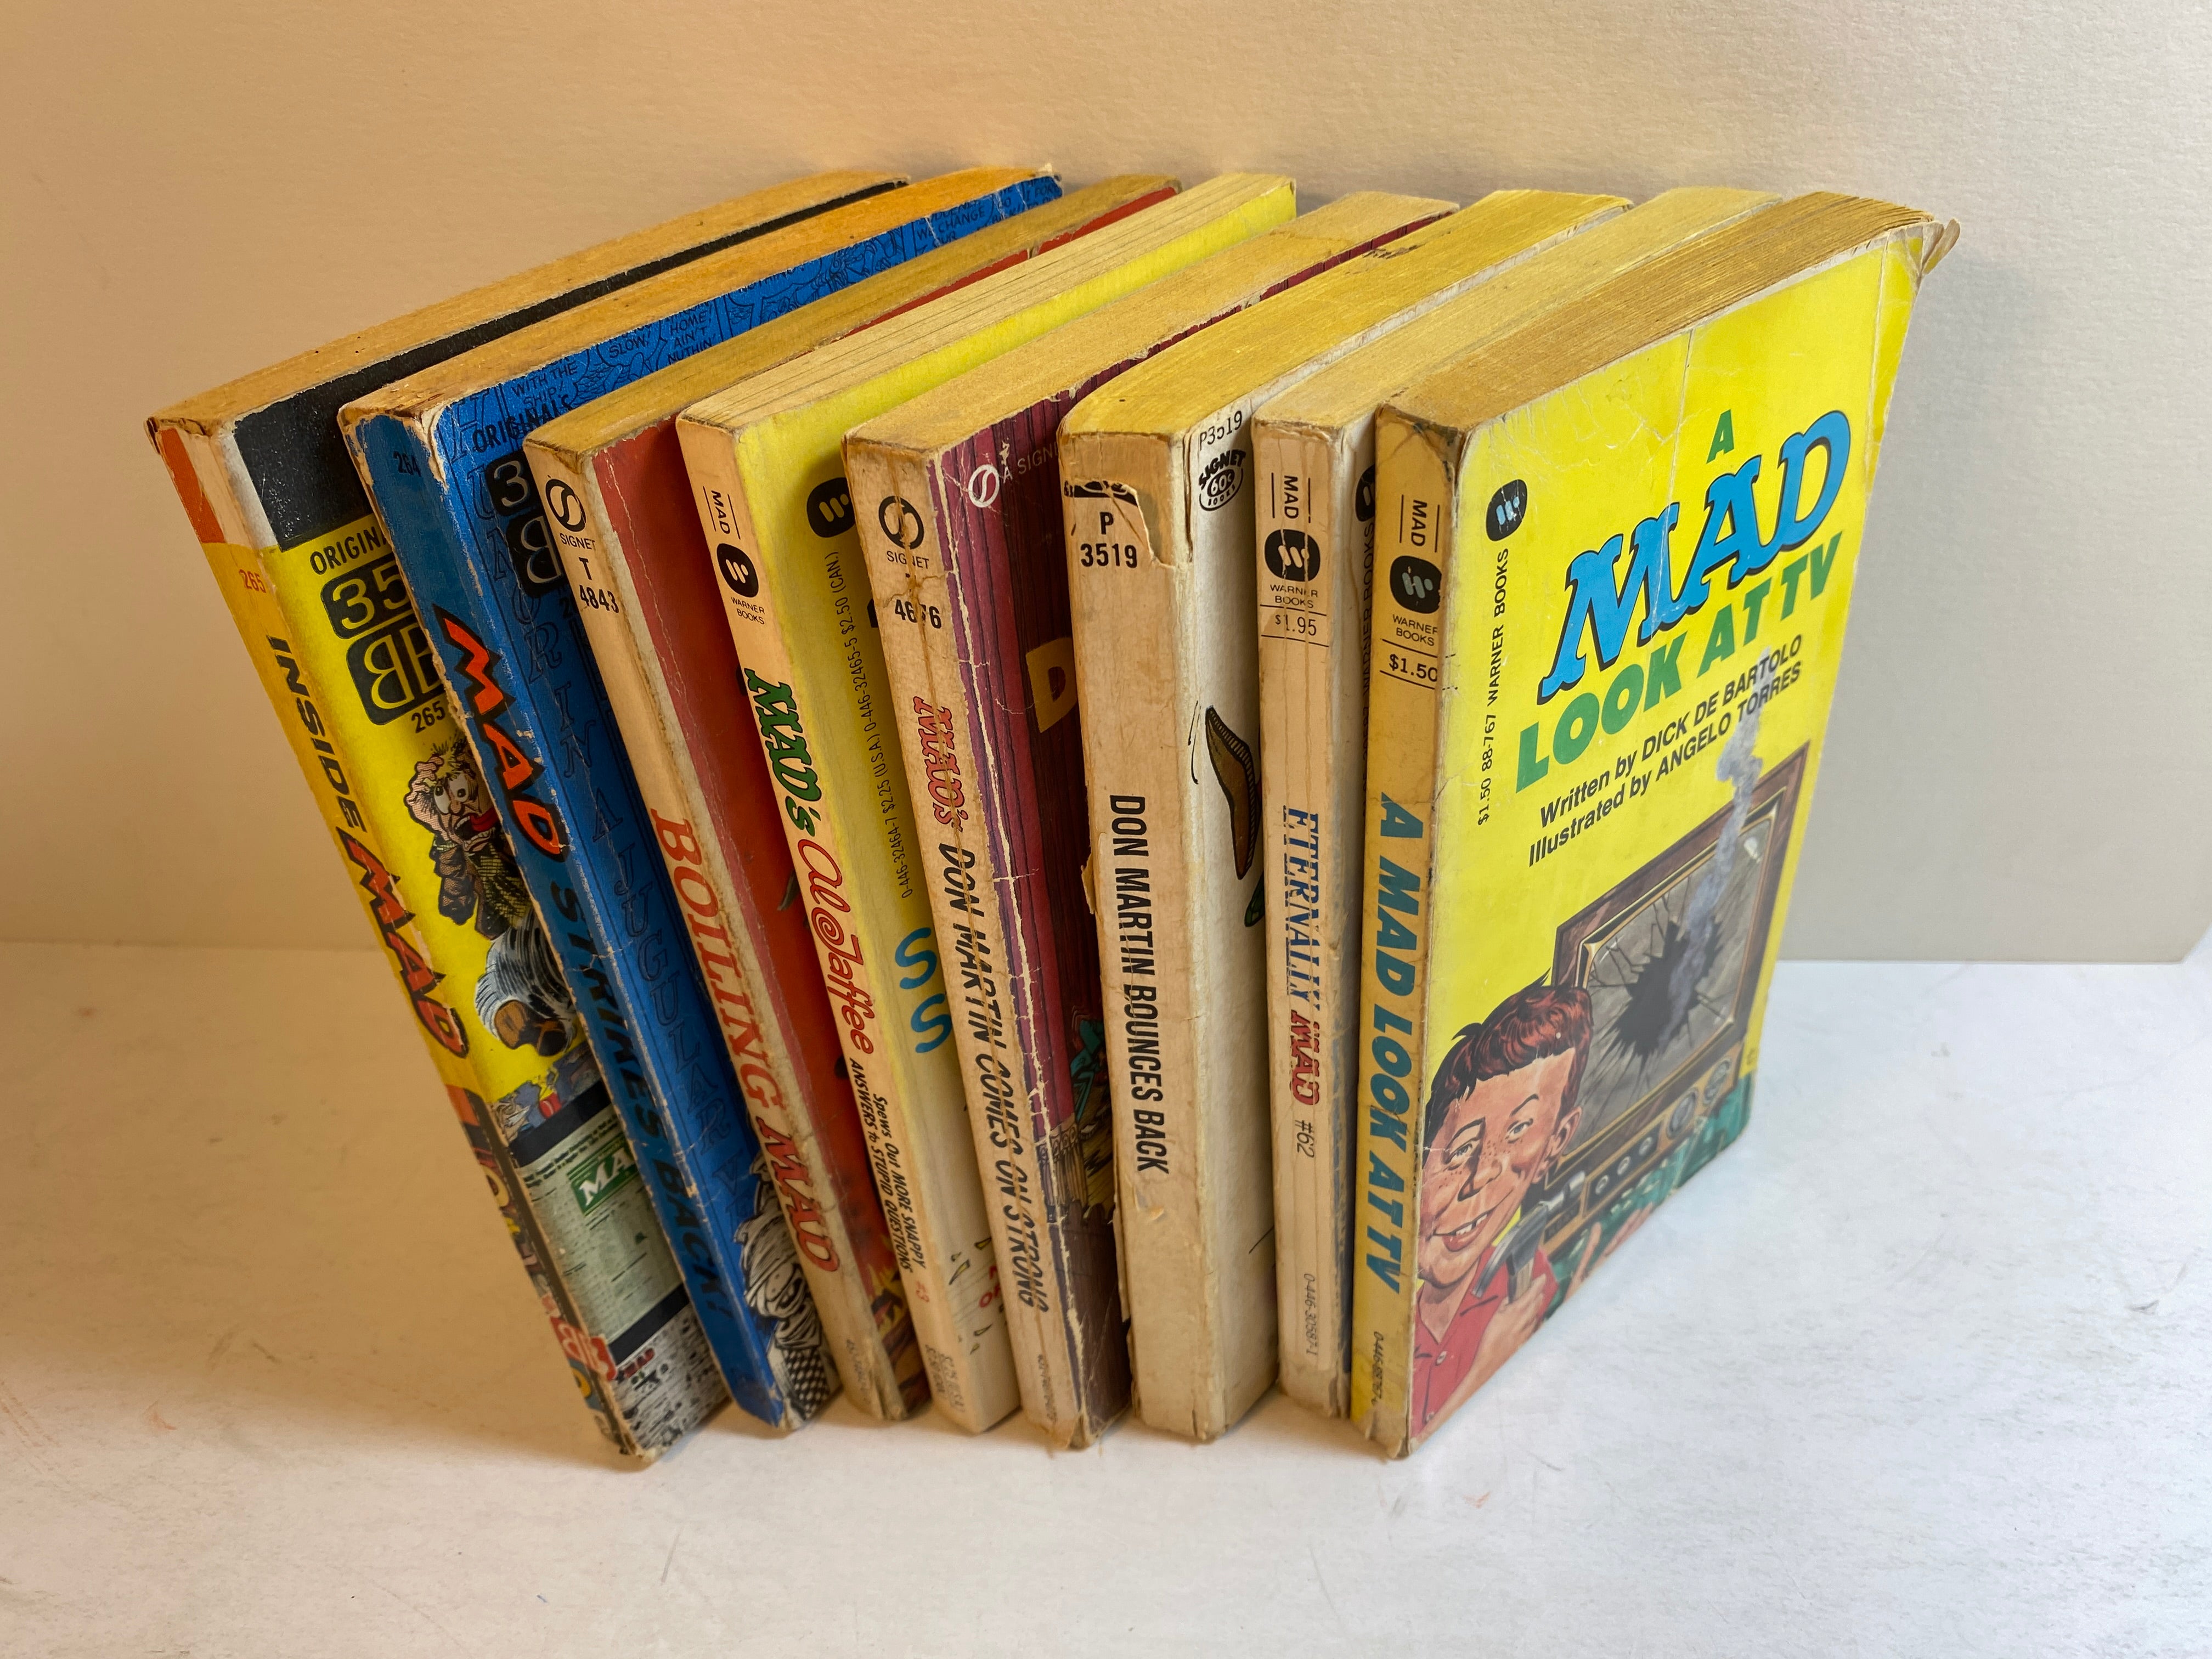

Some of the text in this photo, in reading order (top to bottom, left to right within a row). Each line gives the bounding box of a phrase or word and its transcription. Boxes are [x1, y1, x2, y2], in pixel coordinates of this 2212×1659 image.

[938, 206, 986, 233] CHANGE
[510, 363, 579, 396] WITH THE
[1706, 409, 1736, 464] A
[393, 450, 422, 478] 264
[1002, 466, 1013, 484] A
[1198, 449, 1247, 490] SIGNET
[710, 490, 731, 535] MAD
[1283, 474, 1300, 520] MAD
[558, 532, 596, 552] SIGNET
[1099, 511, 1114, 535] P
[1410, 498, 1428, 548] MAD
[578, 557, 592, 581] T
[824, 550, 847, 594] (CAN.)
[1080, 543, 1138, 569] 3519
[1537, 409, 1852, 707] MAD
[238, 568, 266, 595] 265
[579, 584, 620, 614] 4843
[1274, 595, 1314, 609] BOOKS
[730, 596, 766, 616] WARNER
[737, 608, 766, 625] BOOKS
[834, 596, 857, 636] $2.50
[1275, 614, 1318, 637] $1.95
[1396, 627, 1435, 647] BOOKS
[843, 637, 877, 732] 0-446-32465-5
[1389, 653, 1438, 684] $1.50
[1515, 529, 1844, 795] LOOK AT TV
[1477, 548, 1510, 827] $1.50 88-767 WARNER BOOKS
[411, 700, 446, 733] 265
[1540, 633, 1803, 830] Written by DICK DE BARTOLO
[743, 667, 822, 837] MAD's
[1528, 659, 1803, 868] Illustrated by ANGELO TORRES
[877, 778, 896, 816] $2.25
[266, 634, 470, 1059] INSIDE MAD
[887, 817, 913, 899] 0-446-32464-7
[938, 842, 985, 918] DON
[431, 602, 573, 863] MAD
[550, 879, 667, 1144] STRIKES
[652, 1155, 731, 1316] BACK!
[1282, 804, 1321, 1159] ETERNALLY MAD #62
[952, 923, 1008, 1049] MARTIN
[1109, 794, 1170, 1176] DON MARTIN BOUNCES BACK
[650, 808, 840, 1272] BOILING MAD
[1365, 791, 1424, 1295] A MAD LOOK AT TV
[974, 1052, 1024, 1156] COMES
[849, 1057, 913, 1274] ANSWERS to STUPID QUESTIONS
[872, 1093, 927, 1271] Spews Out MORE SNAPPY
[995, 1160, 1033, 1205] ON
[1007, 1205, 1051, 1314] STRONG
